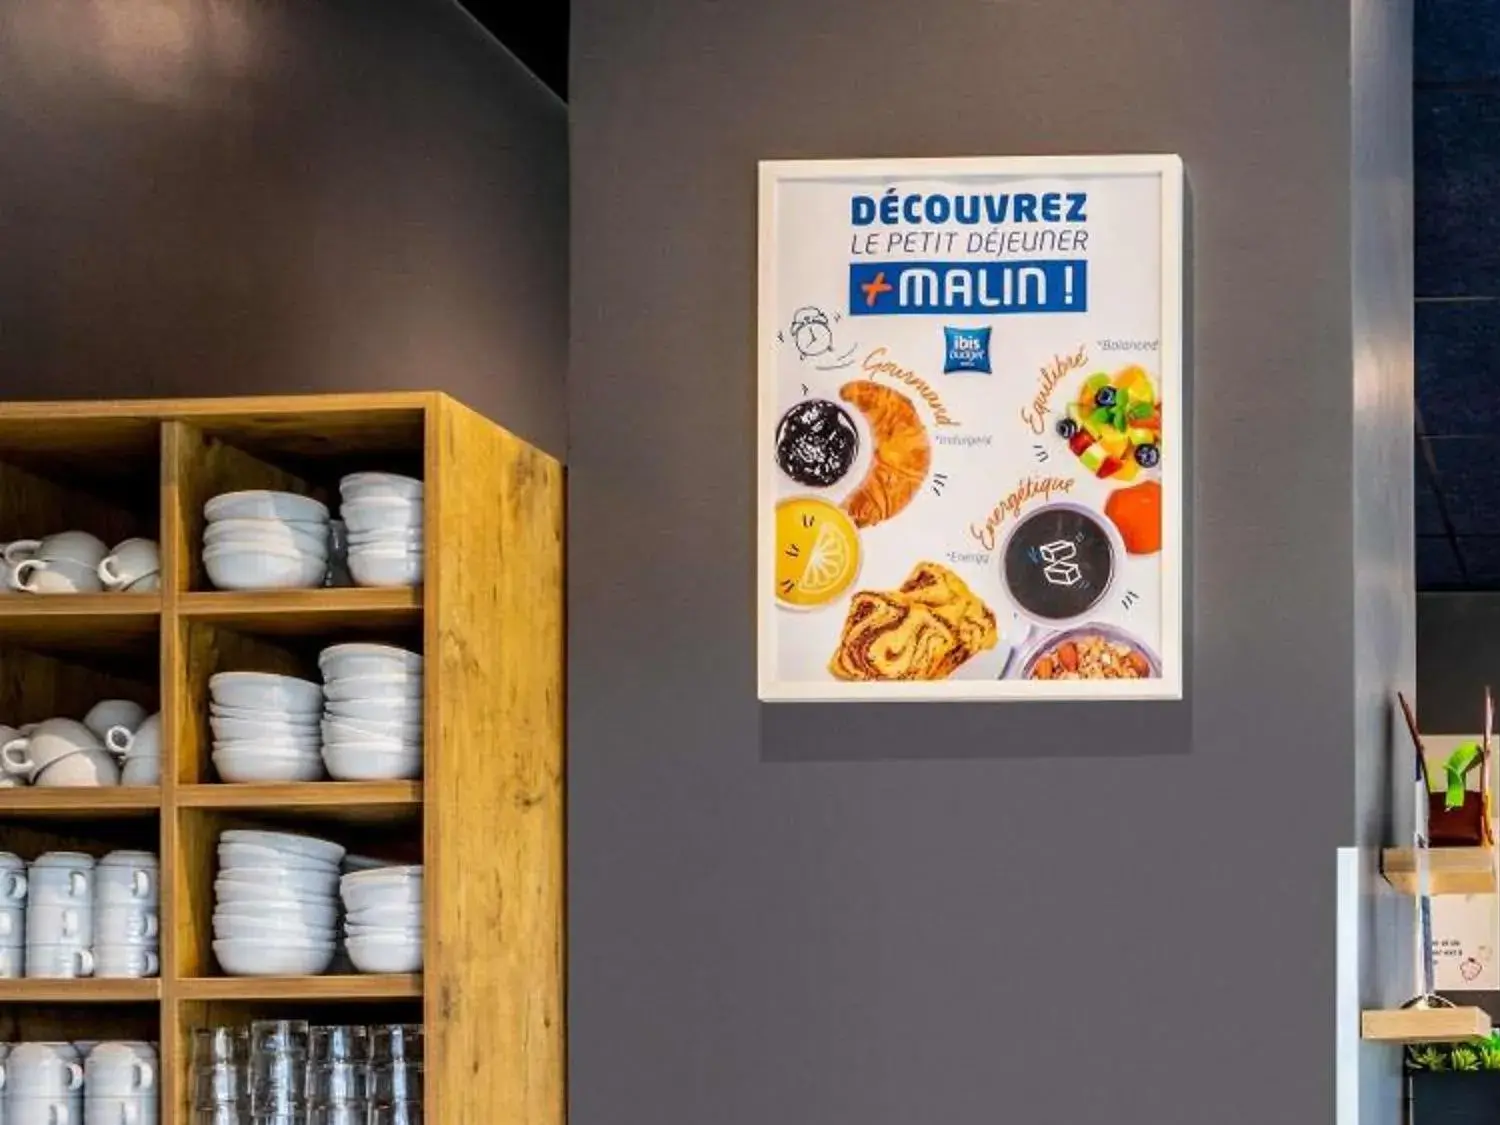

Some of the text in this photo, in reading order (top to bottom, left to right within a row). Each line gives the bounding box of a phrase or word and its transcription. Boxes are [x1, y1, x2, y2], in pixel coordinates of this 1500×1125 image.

[851, 188, 1088, 225] DÉCOUVREZ
[851, 228, 1089, 257] LE PETIT DÉJEUNER
[899, 267, 1047, 307] MALIN
[954, 335, 981, 350] ibis
[863, 347, 961, 426] Gourmand
